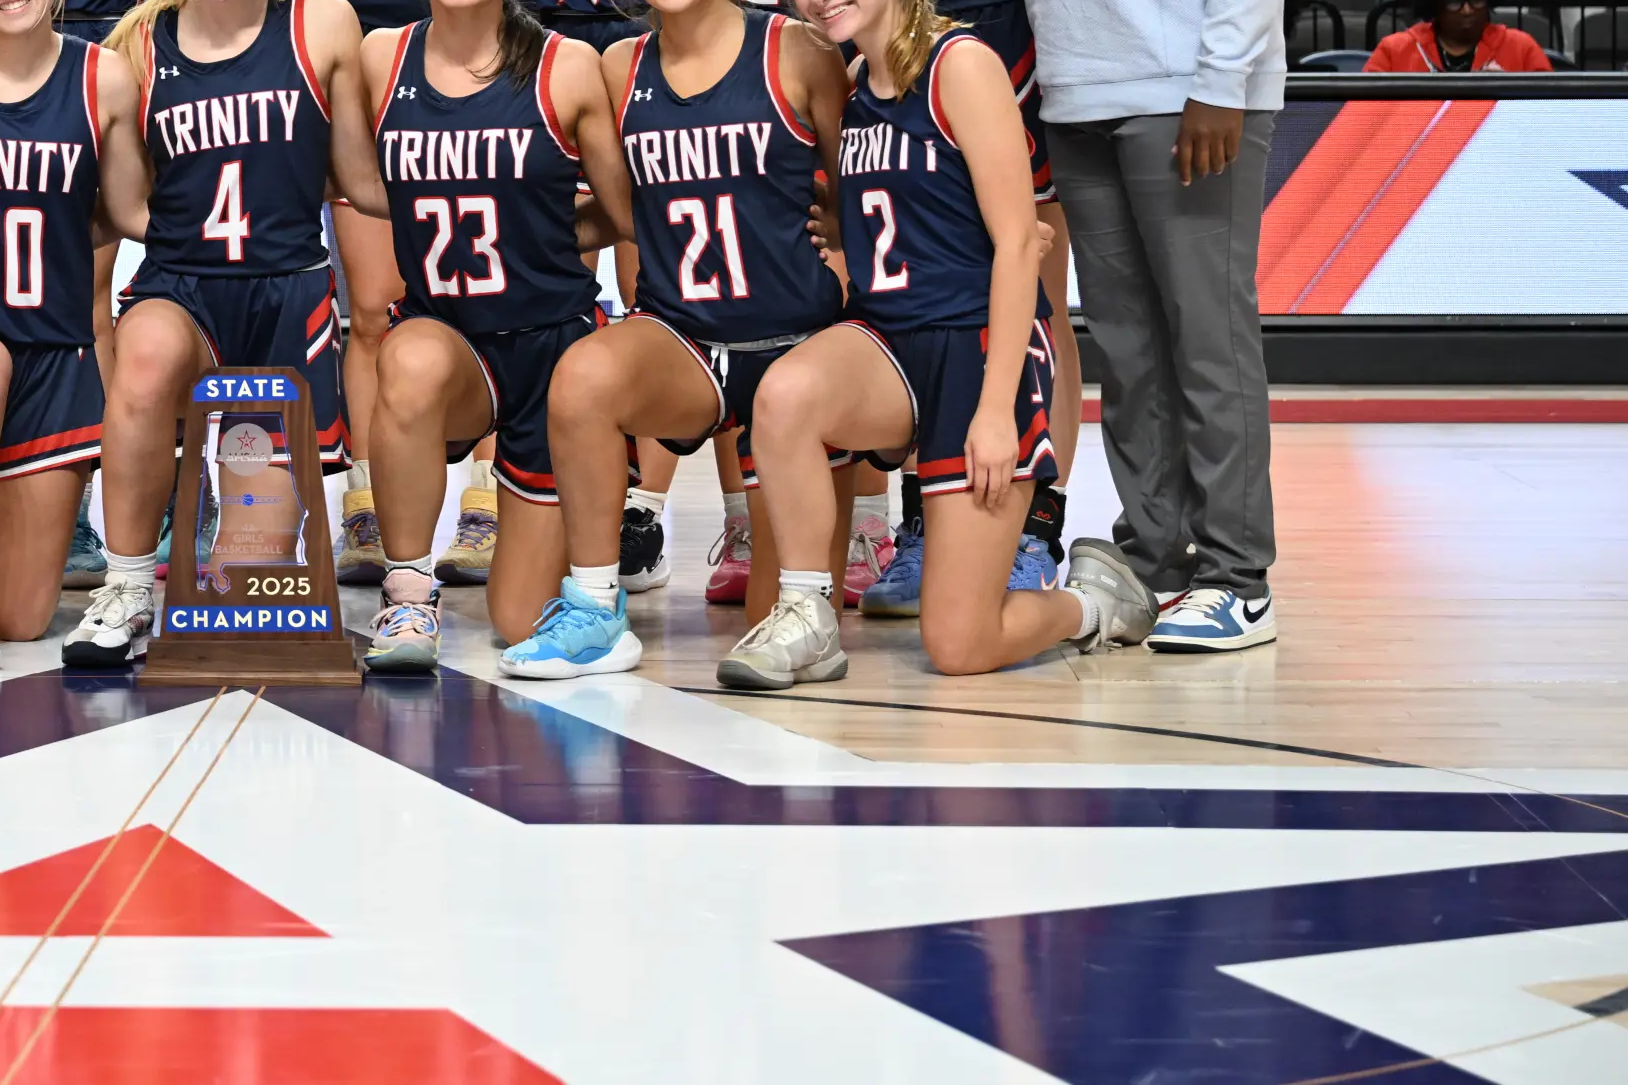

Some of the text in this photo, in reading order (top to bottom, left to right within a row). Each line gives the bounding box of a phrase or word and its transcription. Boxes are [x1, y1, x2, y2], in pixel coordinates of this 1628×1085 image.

[153, 88, 301, 160] TRINITY
[623, 121, 773, 187] TRINITY
[382, 127, 534, 182] TRINITY
[201, 159, 251, 263] 4
[861, 187, 909, 294] 2
[413, 194, 508, 298] 23
[666, 192, 751, 303] 21
[206, 378, 286, 398] STATE
[214, 544, 283, 554] BASKETBALL
[232, 534, 265, 544] GIRLS
[246, 577, 312, 596] 2025
[171, 609, 328, 628] CHAMPION
